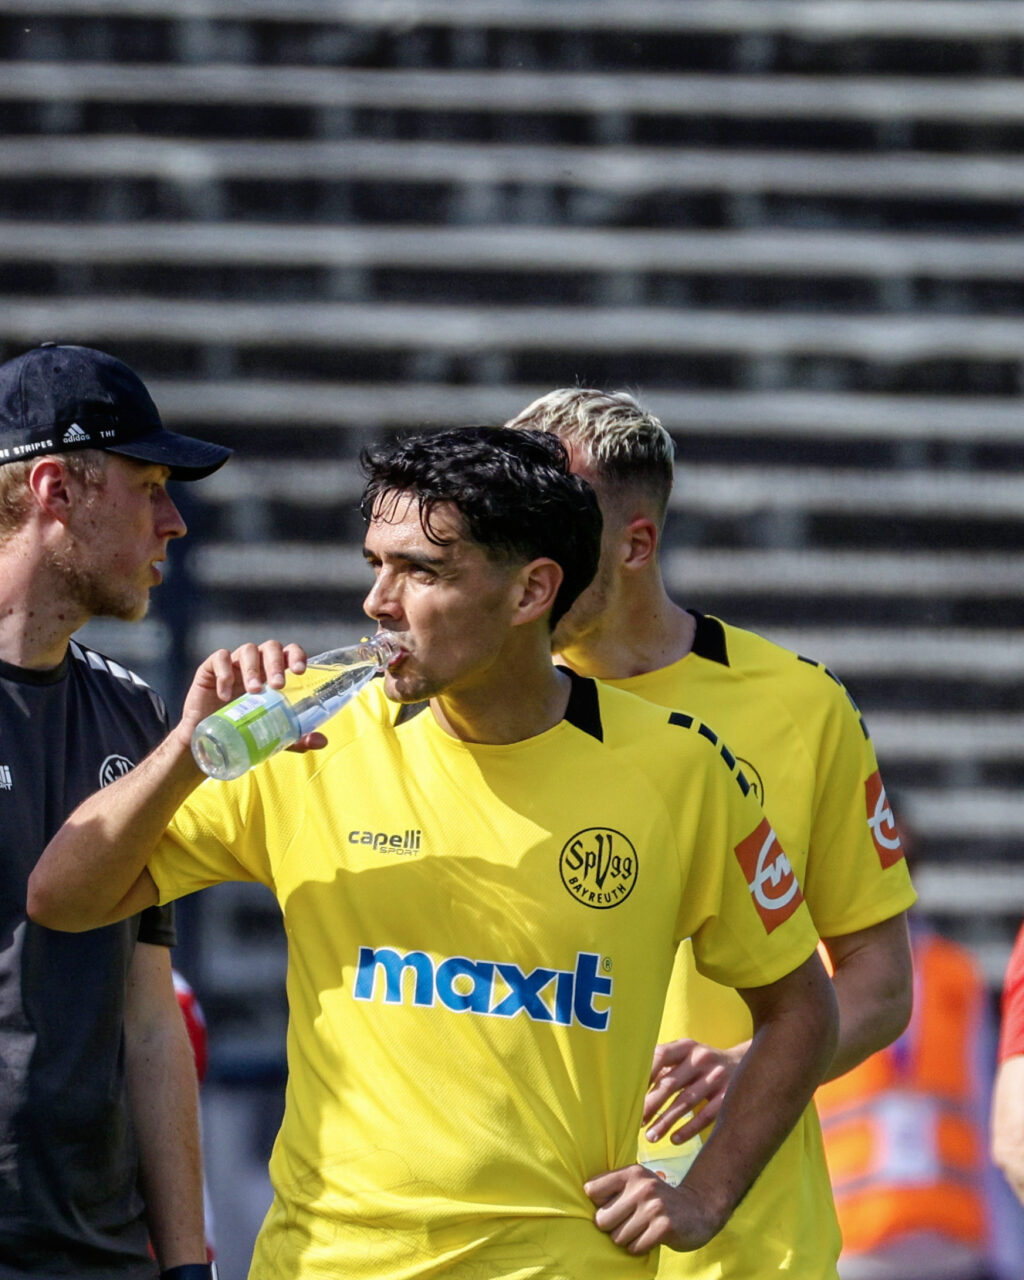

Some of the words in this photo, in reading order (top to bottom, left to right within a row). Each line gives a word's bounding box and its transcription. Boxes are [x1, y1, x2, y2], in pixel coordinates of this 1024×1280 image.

[62, 433, 91, 444] adidas
[99, 429, 116, 439] THE
[12, 439, 54, 455] STRIPES
[348, 830, 422, 851] capelli
[379, 846, 420, 857] SPORT
[568, 876, 627, 904] BAYREUTH
[354, 946, 613, 1032] maxit
